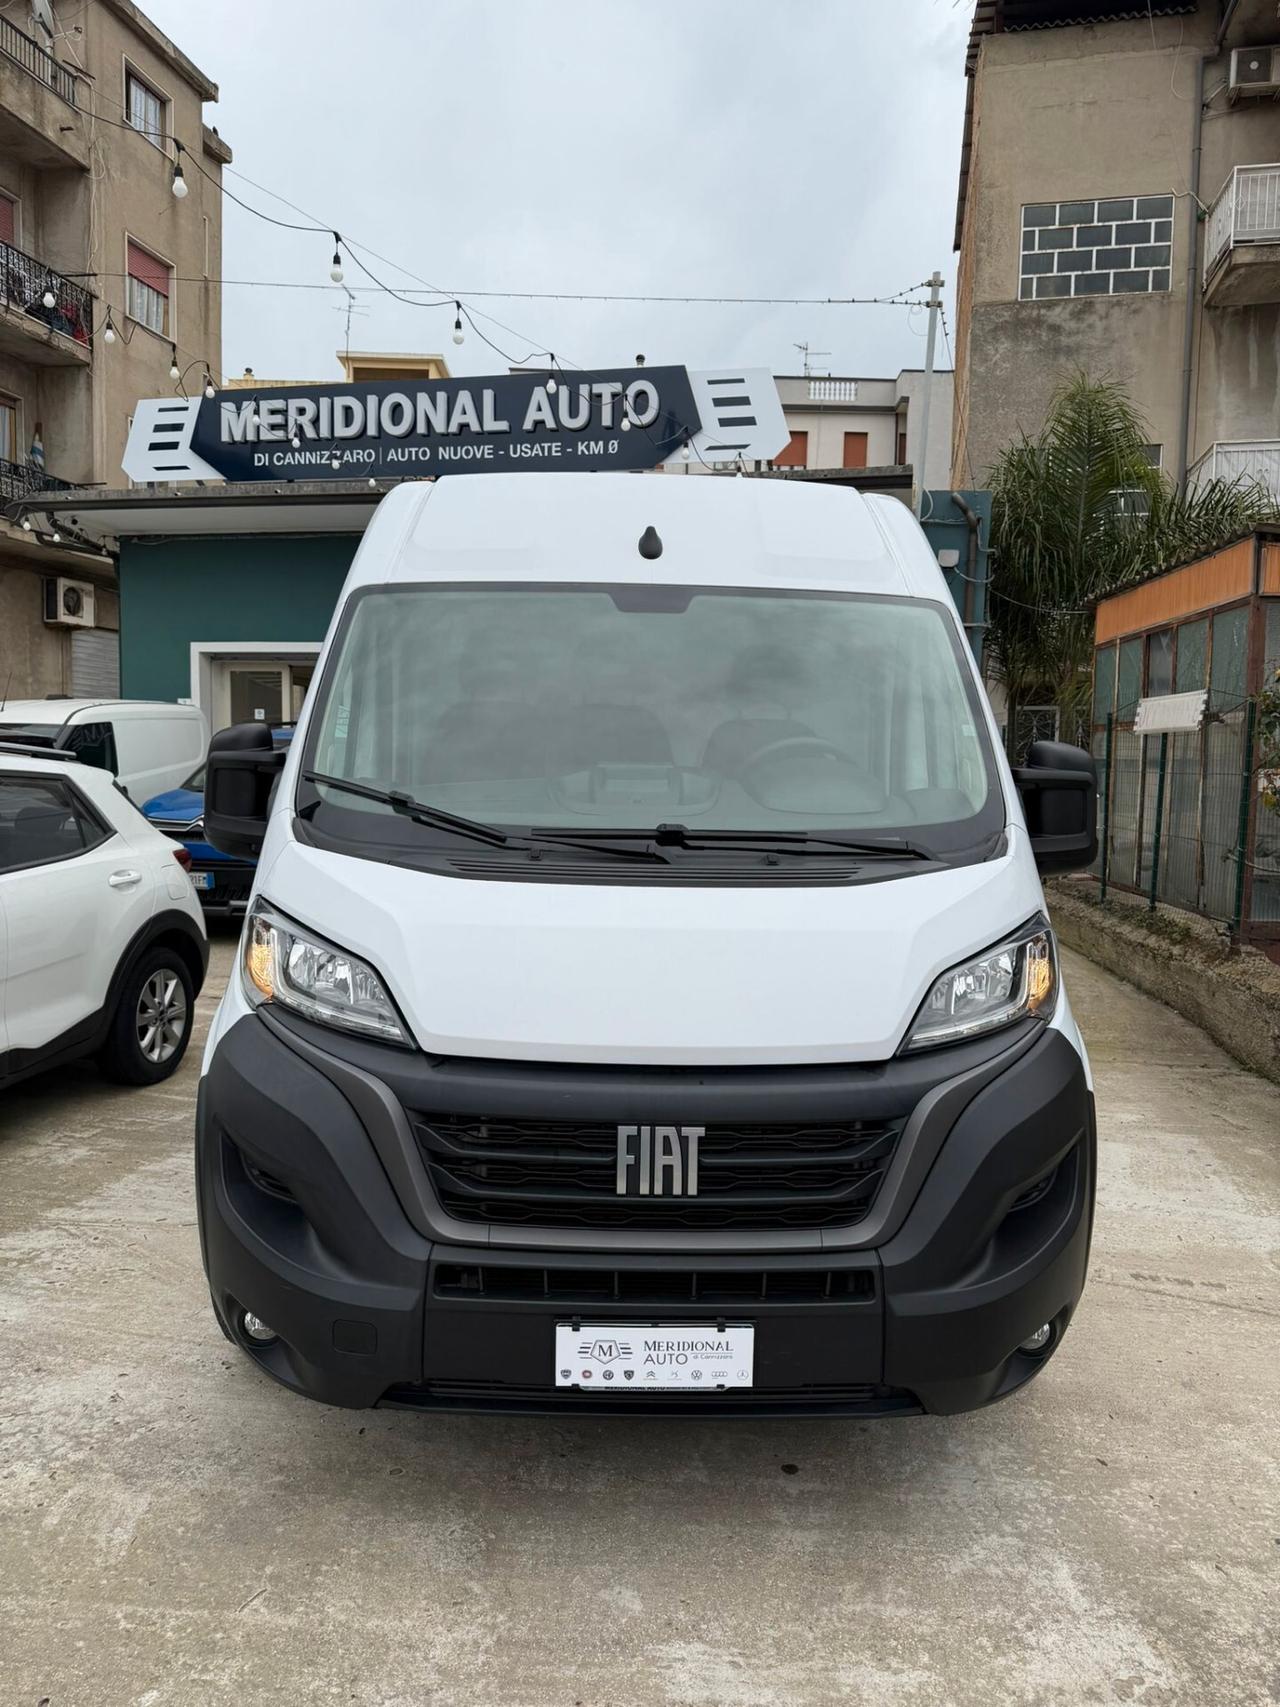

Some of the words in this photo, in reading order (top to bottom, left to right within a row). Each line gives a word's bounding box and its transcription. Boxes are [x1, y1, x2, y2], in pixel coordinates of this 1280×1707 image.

[220, 389, 510, 442] MERIDIONAL
[522, 380, 660, 432] AUTO
[254, 453, 269, 466] DI
[387, 447, 431, 462] AUTO
[438, 445, 494, 460] NUOVE
[509, 442, 562, 458] USATE
[577, 440, 604, 455] KM
[616, 1125, 706, 1196] FIAT
[598, 1344, 613, 1357] M
[643, 1340, 734, 1352] MERIDIONAL
[643, 1352, 689, 1366] AUTO
